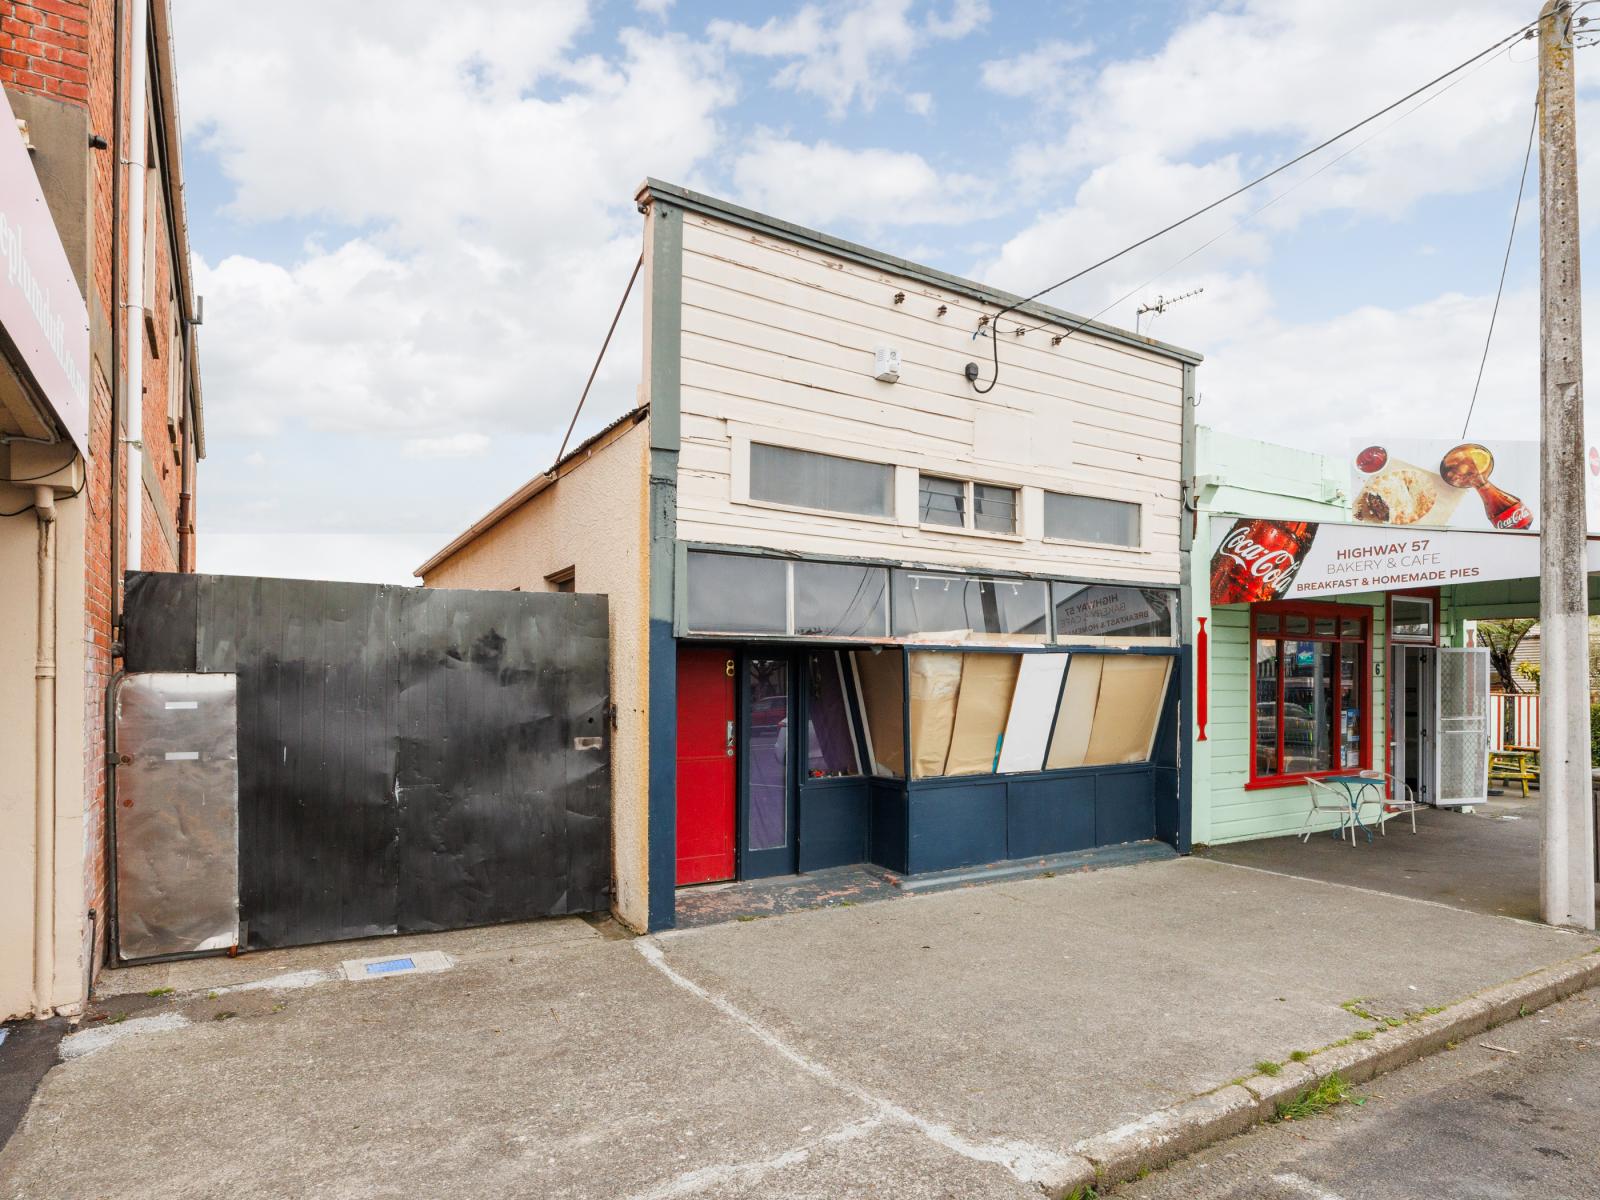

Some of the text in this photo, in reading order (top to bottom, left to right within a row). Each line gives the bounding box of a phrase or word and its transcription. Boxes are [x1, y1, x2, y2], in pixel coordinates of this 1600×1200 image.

[1220, 527, 1300, 593] Coca-Cola
[1336, 539, 1430, 560] HIGHWAY 57
[1327, 552, 1441, 575] BAKERY & CAFE
[1297, 567, 1480, 592] BREAKFAST & HOMEMADE PIES
[1375, 663, 1381, 676] 6
